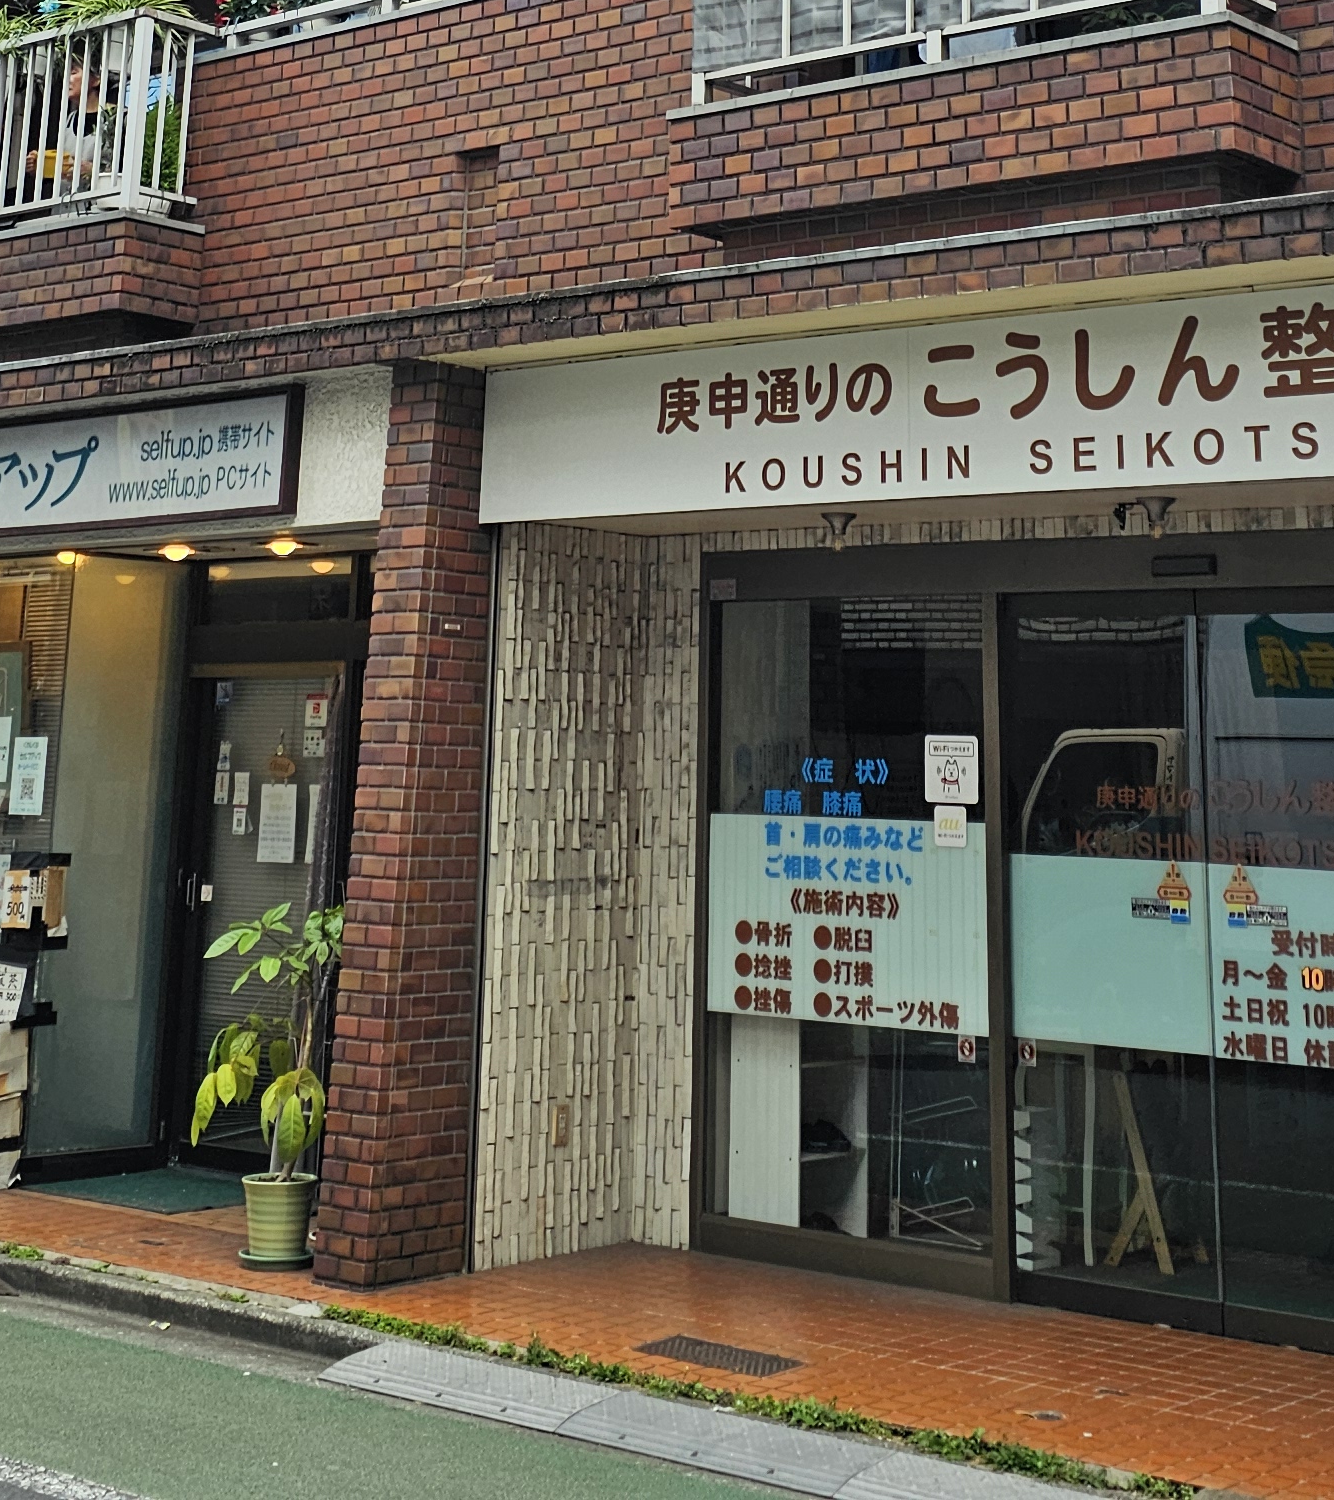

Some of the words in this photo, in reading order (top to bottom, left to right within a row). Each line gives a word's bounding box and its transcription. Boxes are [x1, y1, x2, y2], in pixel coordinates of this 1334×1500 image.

[656, 362, 893, 434] 庚申通りの
[140, 428, 213, 462] selfup.jp
[217, 420, 275, 453] 携帯サイト
[108, 468, 211, 504] www.selfup.jp
[215, 461, 272, 492] PCサイト
[724, 444, 971, 494] KOUSHIN
[763, 789, 802, 815] 腰痛
[822, 791, 862, 817] 膝痛
[764, 821, 924, 853] 首・肩の痛みなど
[939, 818, 962, 831] au
[1075, 829, 1202, 862] KOUSHIN
[764, 853, 912, 886] ご相談ください。
[790, 887, 900, 920] 《施術内容》
[1222, 959, 1288, 991] 月～金
[1222, 995, 1290, 1027] 土日祝
[1223, 1030, 1289, 1063] 水曜日
